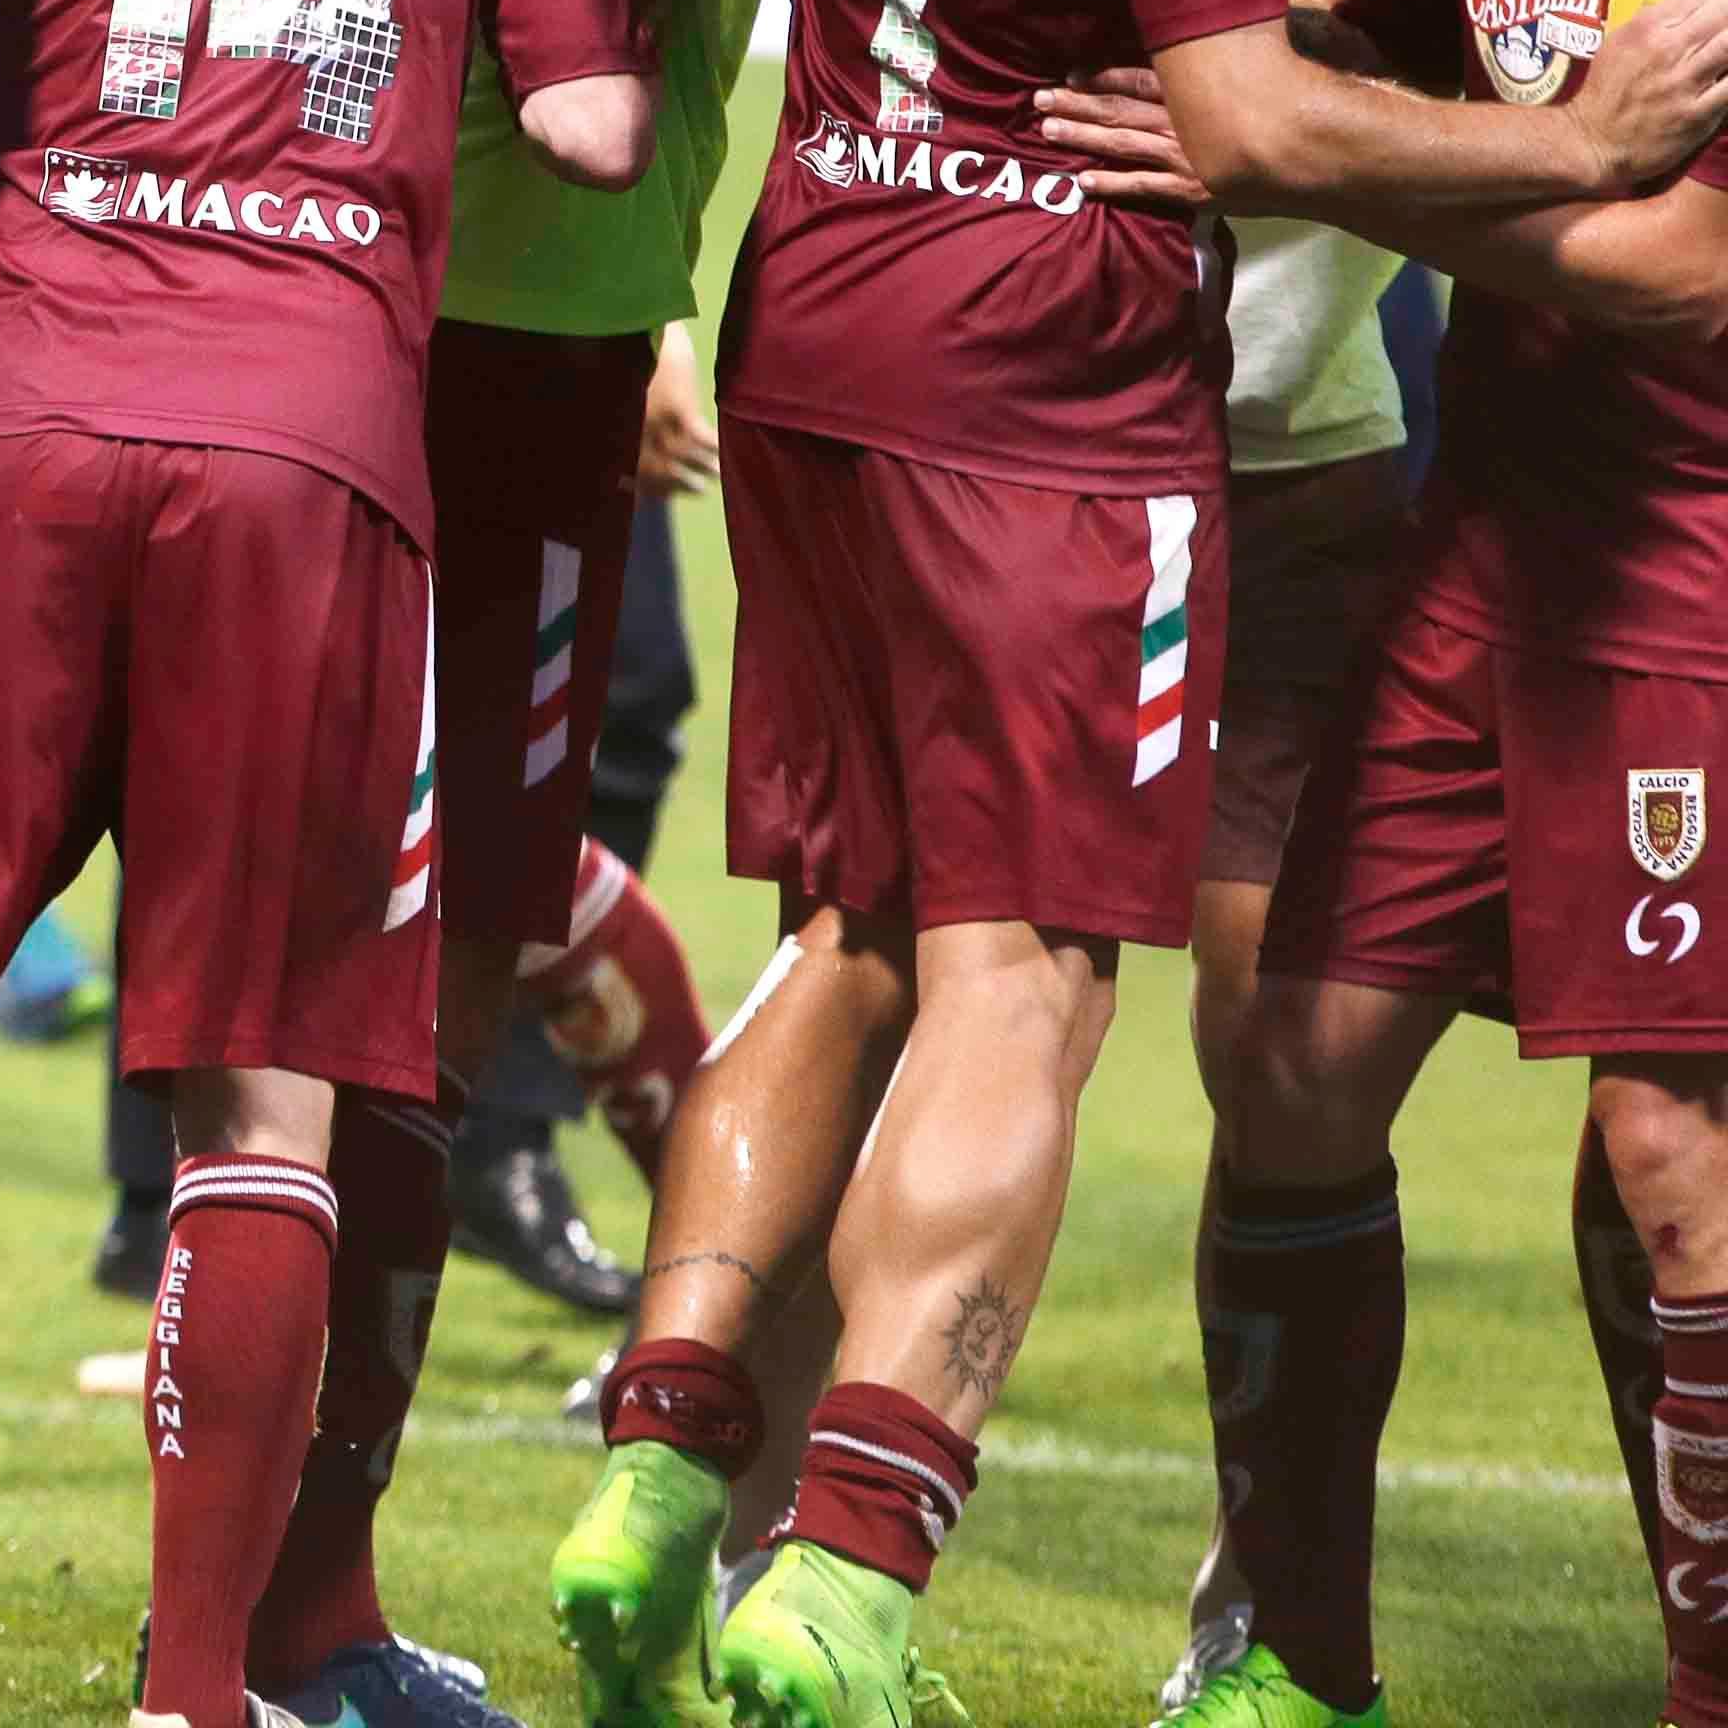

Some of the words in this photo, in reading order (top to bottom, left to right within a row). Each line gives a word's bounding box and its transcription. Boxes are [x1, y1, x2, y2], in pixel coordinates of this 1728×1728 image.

[127, 172, 382, 247] MACAO
[857, 133, 1085, 216] MACAO
[1638, 776, 1690, 789] CALCIO
[152, 1247, 193, 1460] REGGIANA
